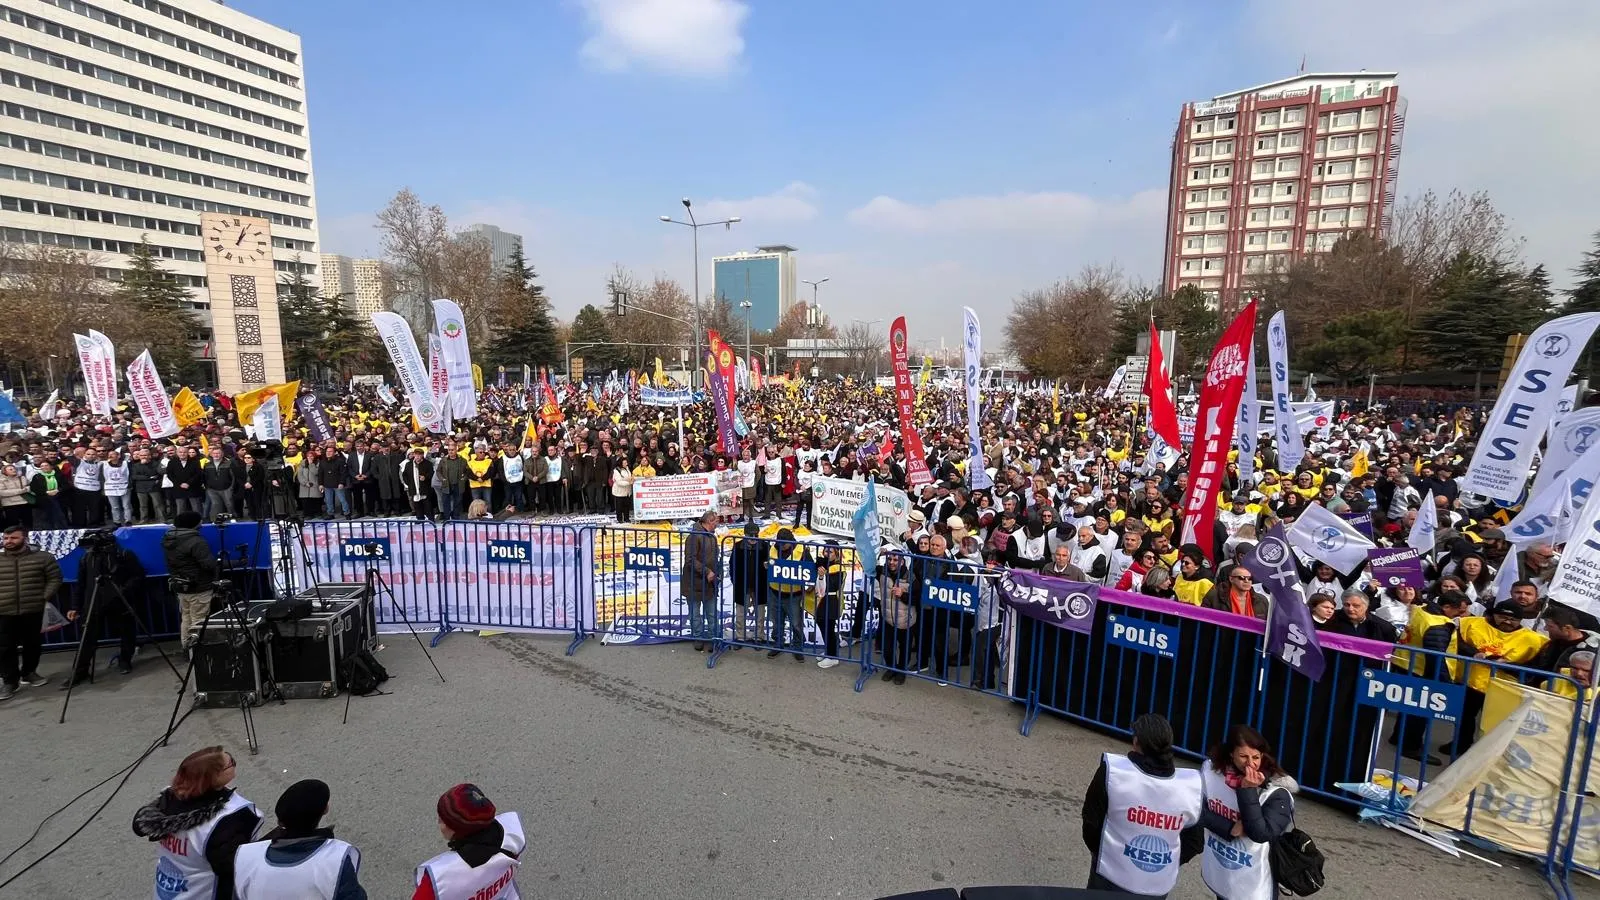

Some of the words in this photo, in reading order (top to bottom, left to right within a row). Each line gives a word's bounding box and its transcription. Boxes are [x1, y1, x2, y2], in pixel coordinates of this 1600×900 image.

[1275, 361, 1290, 445] SES
[1485, 368, 1552, 461] SES
[909, 460, 925, 471] SEN
[829, 487, 845, 497] TÜM
[877, 495, 891, 504] SEN
[345, 541, 384, 556] POLS
[491, 544, 526, 559] POLİS
[628, 551, 665, 567] POLİS
[1574, 556, 1600, 571] SAĞL
[773, 565, 811, 581] POLİS
[1562, 563, 1593, 579] OSYAL
[1563, 573, 1600, 591] EMEKÇİL
[928, 585, 972, 607] POLİS
[1560, 582, 1600, 602] SENDİKA
[1113, 623, 1168, 650] POLİS
[1367, 679, 1447, 712] POLİS
[1126, 805, 1184, 831] GÖREVLİ
[1123, 843, 1173, 865] KESK
[1207, 835, 1253, 868] KESK
